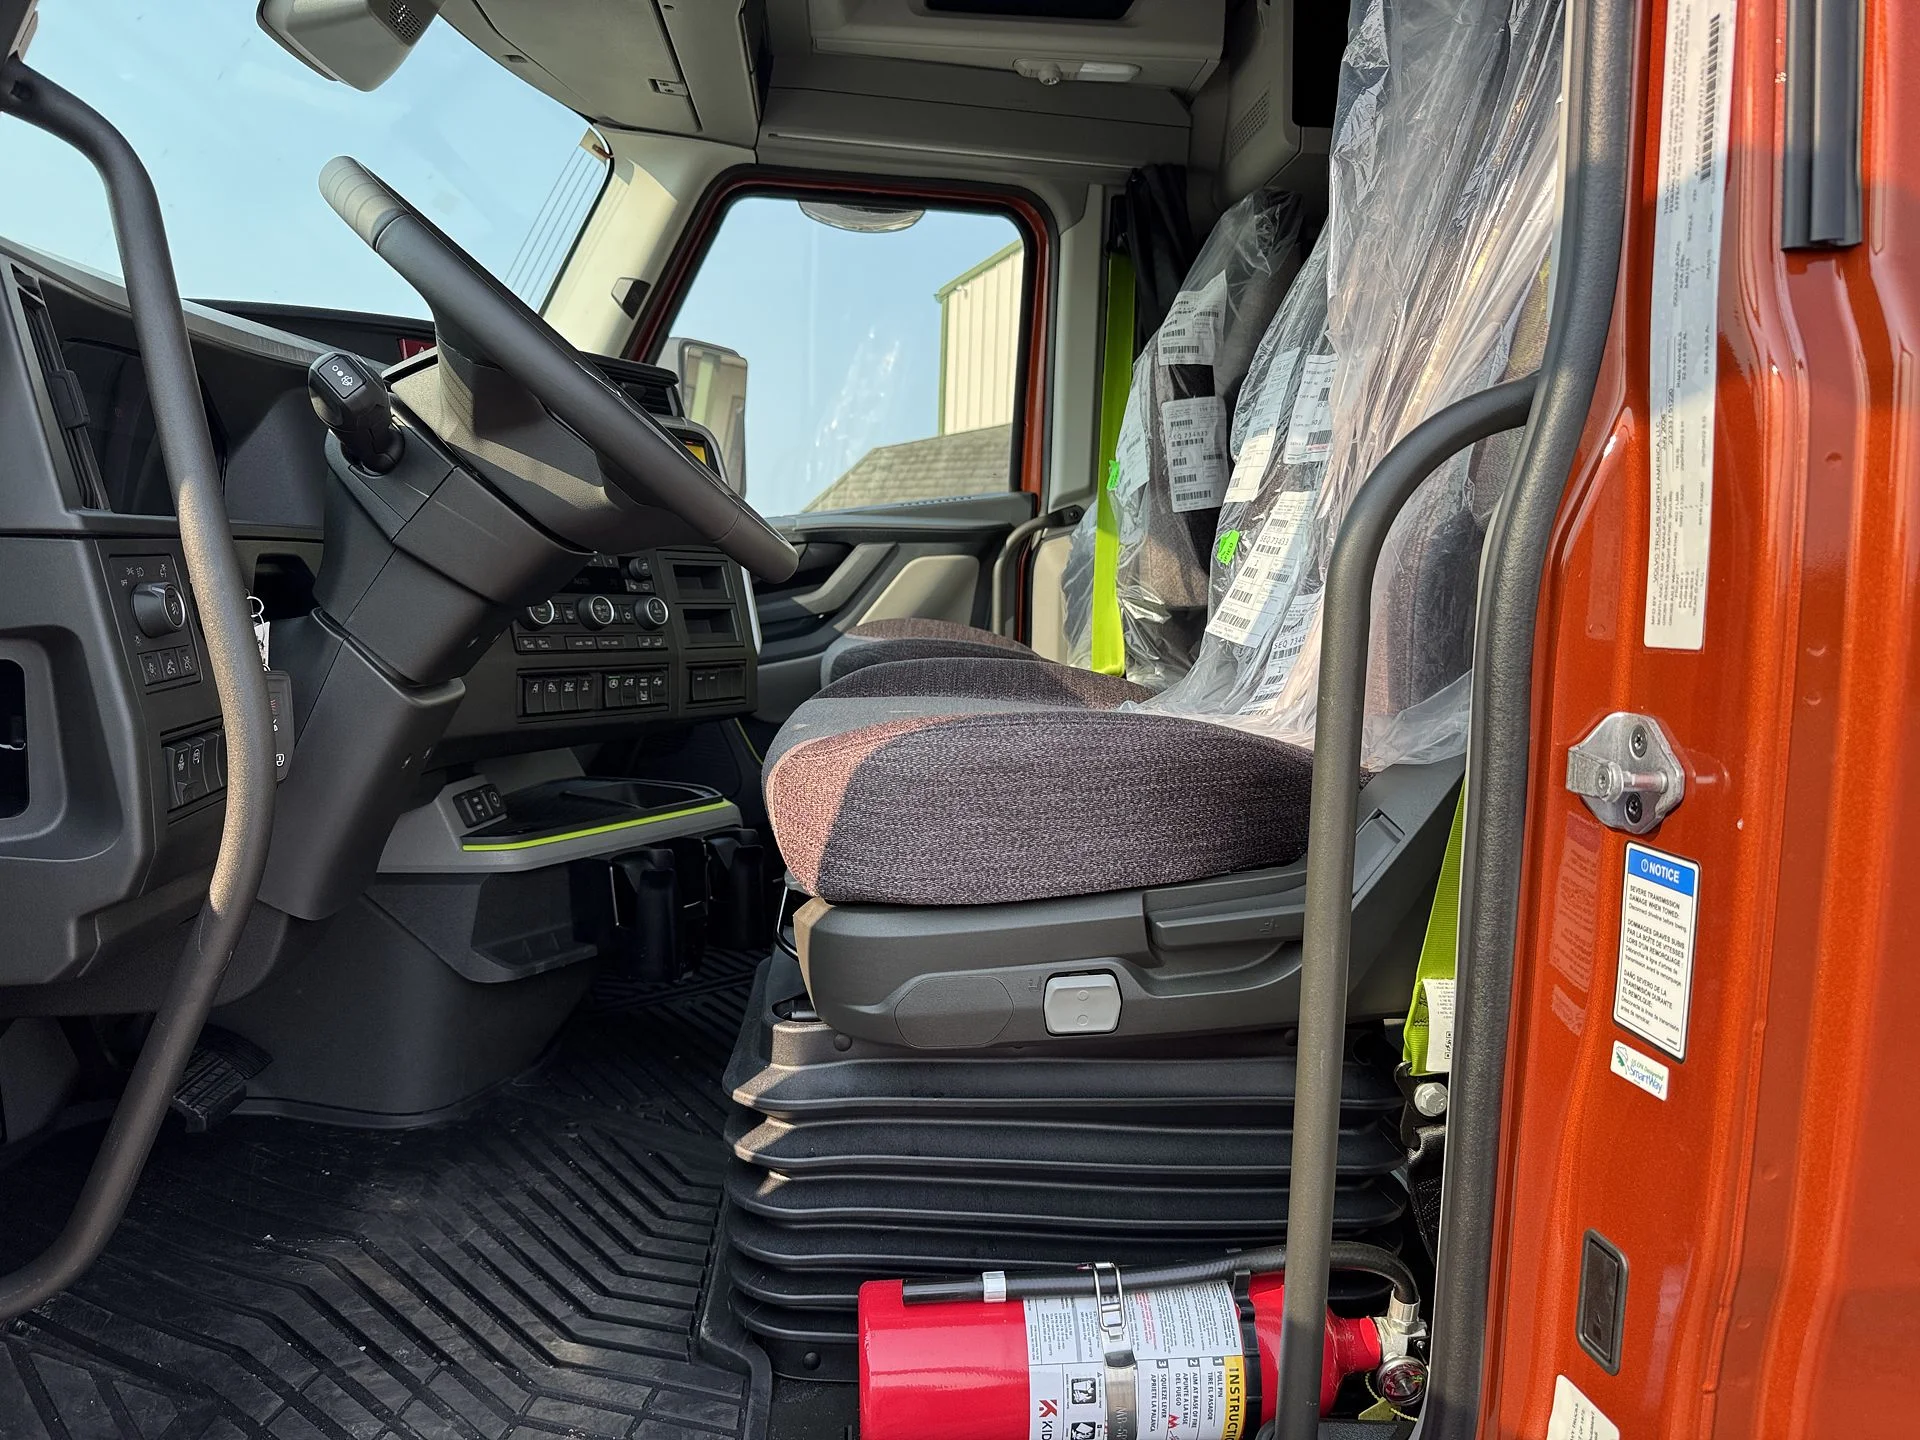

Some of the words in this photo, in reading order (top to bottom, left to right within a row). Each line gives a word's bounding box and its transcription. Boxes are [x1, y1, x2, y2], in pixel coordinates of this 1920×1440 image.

[1274, 640, 1287, 649] SEQ
[1649, 862, 1680, 884] NOTICE
[1629, 894, 1647, 906] DAMAGE
[1648, 901, 1662, 912] WHEN
[1630, 885, 1647, 897] SEVERE
[1647, 892, 1680, 909] TRANSMISSION
[1627, 927, 1636, 936] PAR
[1656, 940, 1662, 948] DE
[1663, 943, 1684, 958] VITESSES
[1628, 919, 1652, 934] DOMMAGES
[1653, 928, 1670, 942] GRAVES
[1671, 938, 1685, 949] SUBIS
[1626, 936, 1638, 947] LORS
[1639, 942, 1649, 952] D'UN
[1649, 946, 1681, 967] REMORQUAGE
[1624, 969, 1636, 982] DAÑO
[1636, 976, 1654, 989] SEVERO
[1654, 984, 1662, 993] DE
[1622, 987, 1629, 996] EL
[1652, 992, 1673, 1010] DURANTE
[1630, 1066, 1662, 1094] SmartWay
[1193, 1386, 1198, 1394] AT
[1151, 1400, 1156, 1409] LA
[1183, 1403, 1189, 1411] LA
